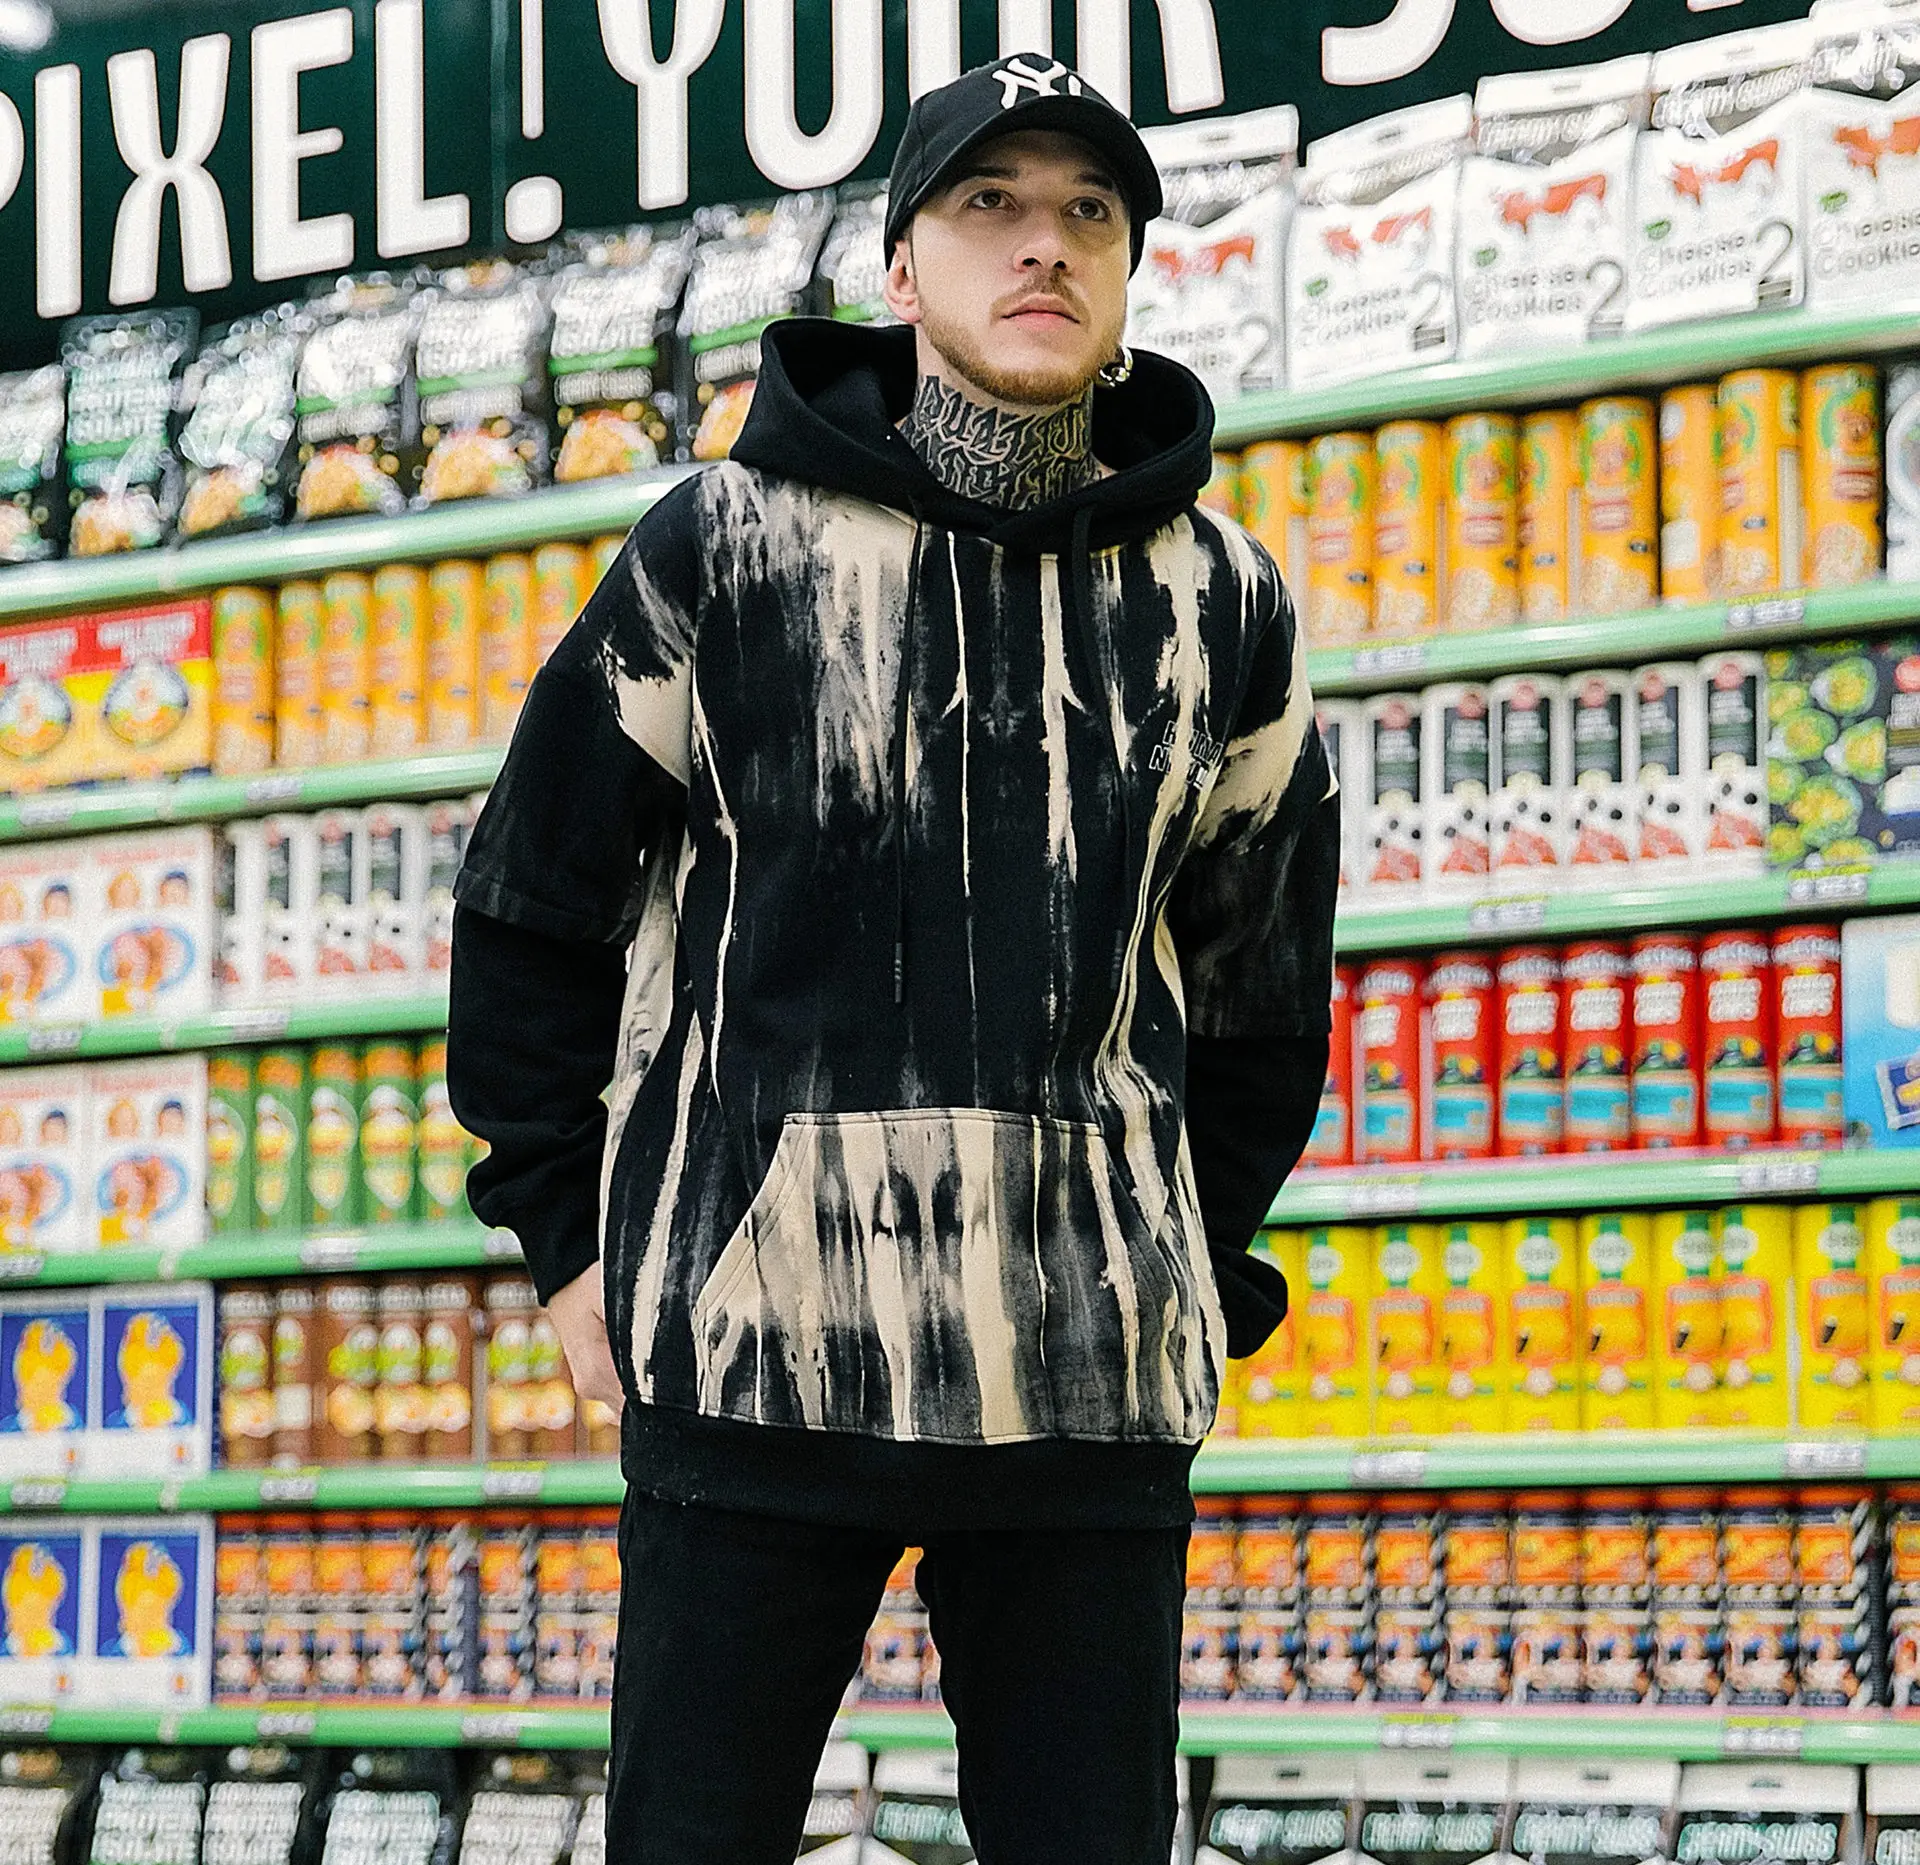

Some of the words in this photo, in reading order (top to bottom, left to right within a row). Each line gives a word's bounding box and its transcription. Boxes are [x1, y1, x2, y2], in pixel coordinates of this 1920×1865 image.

[0, 0, 563, 318] IXEL!
[1757, 219, 1794, 288] 2
[1411, 272, 1446, 333] 2
[1586, 259, 1626, 323] 2
[1240, 315, 1274, 376] 2
